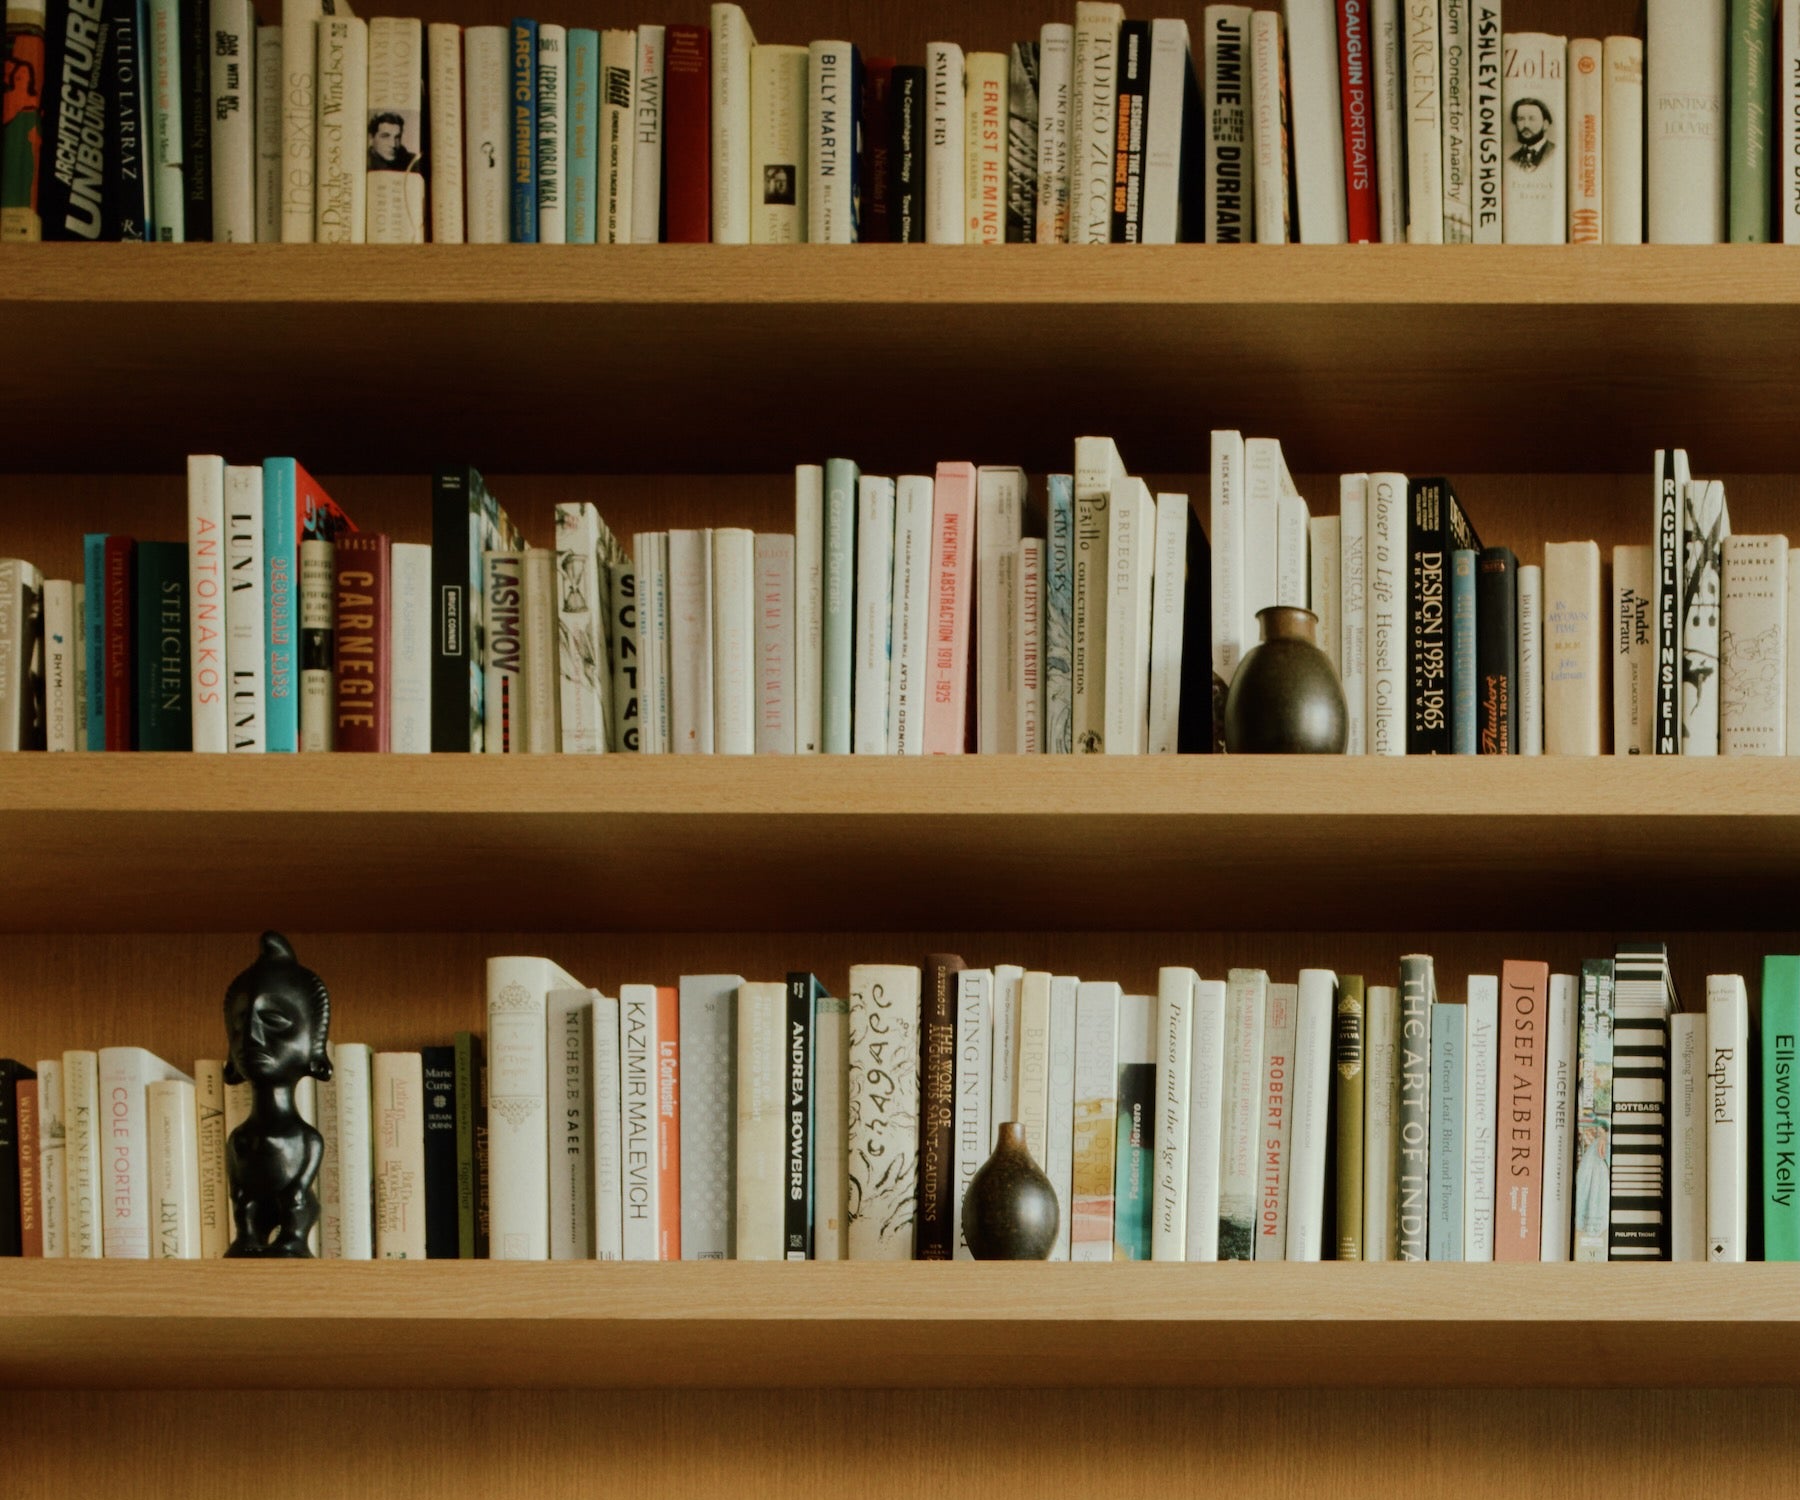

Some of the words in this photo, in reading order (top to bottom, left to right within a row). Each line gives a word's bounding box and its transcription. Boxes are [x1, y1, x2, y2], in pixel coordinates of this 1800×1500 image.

[113, 18, 133, 83] JULIO
[516, 27, 531, 101] ARCTIC
[644, 44, 655, 74] JAMIE
[1216, 18, 1241, 105] JIMMIE
[1345, 0, 1363, 84] GAUGUIN
[1411, 4, 1435, 128] SARGENT
[1504, 49, 1561, 79] Zola
[323, 41, 343, 115] Windsor
[539, 65, 557, 118] ZEPPELINS
[640, 76, 658, 144] WYETH
[821, 54, 836, 104] BILLY
[903, 79, 912, 94] The
[934, 52, 947, 111] SMALL
[119, 91, 137, 180] LARRAZ
[323, 123, 342, 139] of
[516, 106, 531, 183] AIRMEN
[539, 122, 556, 133] OF
[821, 111, 836, 176] MARTIN
[902, 96, 912, 151] Copenhagen
[934, 117, 946, 148] FRY
[983, 81, 998, 152] ERNEST
[1349, 90, 1369, 190] PORTRAITS
[65, 92, 105, 239] UNBOUND
[322, 146, 342, 226] Duchess
[539, 138, 557, 176] WORLD
[901, 153, 912, 183] Trilogy
[539, 179, 557, 202] WAR
[1216, 146, 1241, 243] DURHAM
[942, 513, 959, 568] INVENTING
[1053, 509, 1067, 539] KIM
[1376, 482, 1393, 541] Closer
[1663, 479, 1675, 585] RACHEL
[230, 514, 253, 594] LUNA
[1053, 543, 1067, 592] JONES
[1373, 568, 1393, 602] Life
[1376, 545, 1391, 561] to
[196, 517, 219, 705] ANTONAKOS
[448, 591, 456, 617] BRUCE
[938, 572, 956, 642] ABSTRACTION
[1077, 562, 1085, 644] COLLECTIBLES
[1422, 552, 1443, 634] DESIGN
[1620, 588, 1633, 655] Malraux
[1635, 596, 1650, 645] André
[161, 581, 181, 711] STEICHEN
[338, 571, 375, 729] CARNEGIE
[448, 619, 457, 650] CONNER
[1376, 613, 1392, 672] Hessel
[1077, 647, 1085, 695] EDITION
[1662, 594, 1674, 753] FEINSTEIN
[233, 670, 255, 750] LUNA
[627, 1001, 646, 1096] KAZIMIR
[661, 1041, 676, 1056] Le
[1167, 1002, 1182, 1063] Picasso
[1509, 982, 1535, 1067] JOSEF
[661, 1058, 676, 1118] Corbusier
[792, 1021, 804, 1106] ANDREA
[1167, 1069, 1179, 1103] and
[1267, 1056, 1285, 1130] ROBERT
[1556, 1060, 1567, 1097] ALICE
[1708, 1047, 1735, 1125] Raphael
[1775, 1034, 1796, 1145] Ellsworth
[112, 1087, 130, 1138] COLE
[1166, 1110, 1180, 1135] the
[1511, 1075, 1532, 1177] ALBERS
[1555, 1100, 1566, 1130] NEEL
[76, 1105, 91, 1189] KENNETH
[629, 1101, 648, 1220] MALEVICH
[791, 1111, 803, 1200] BOWERS
[1162, 1142, 1178, 1170] Age
[1772, 1151, 1796, 1207] Kelly
[114, 1146, 132, 1219] PORTER
[1162, 1176, 1177, 1194] of
[1263, 1139, 1281, 1237] SMITHSON
[78, 1196, 93, 1254] CLARK
[1164, 1198, 1177, 1233] Iron
